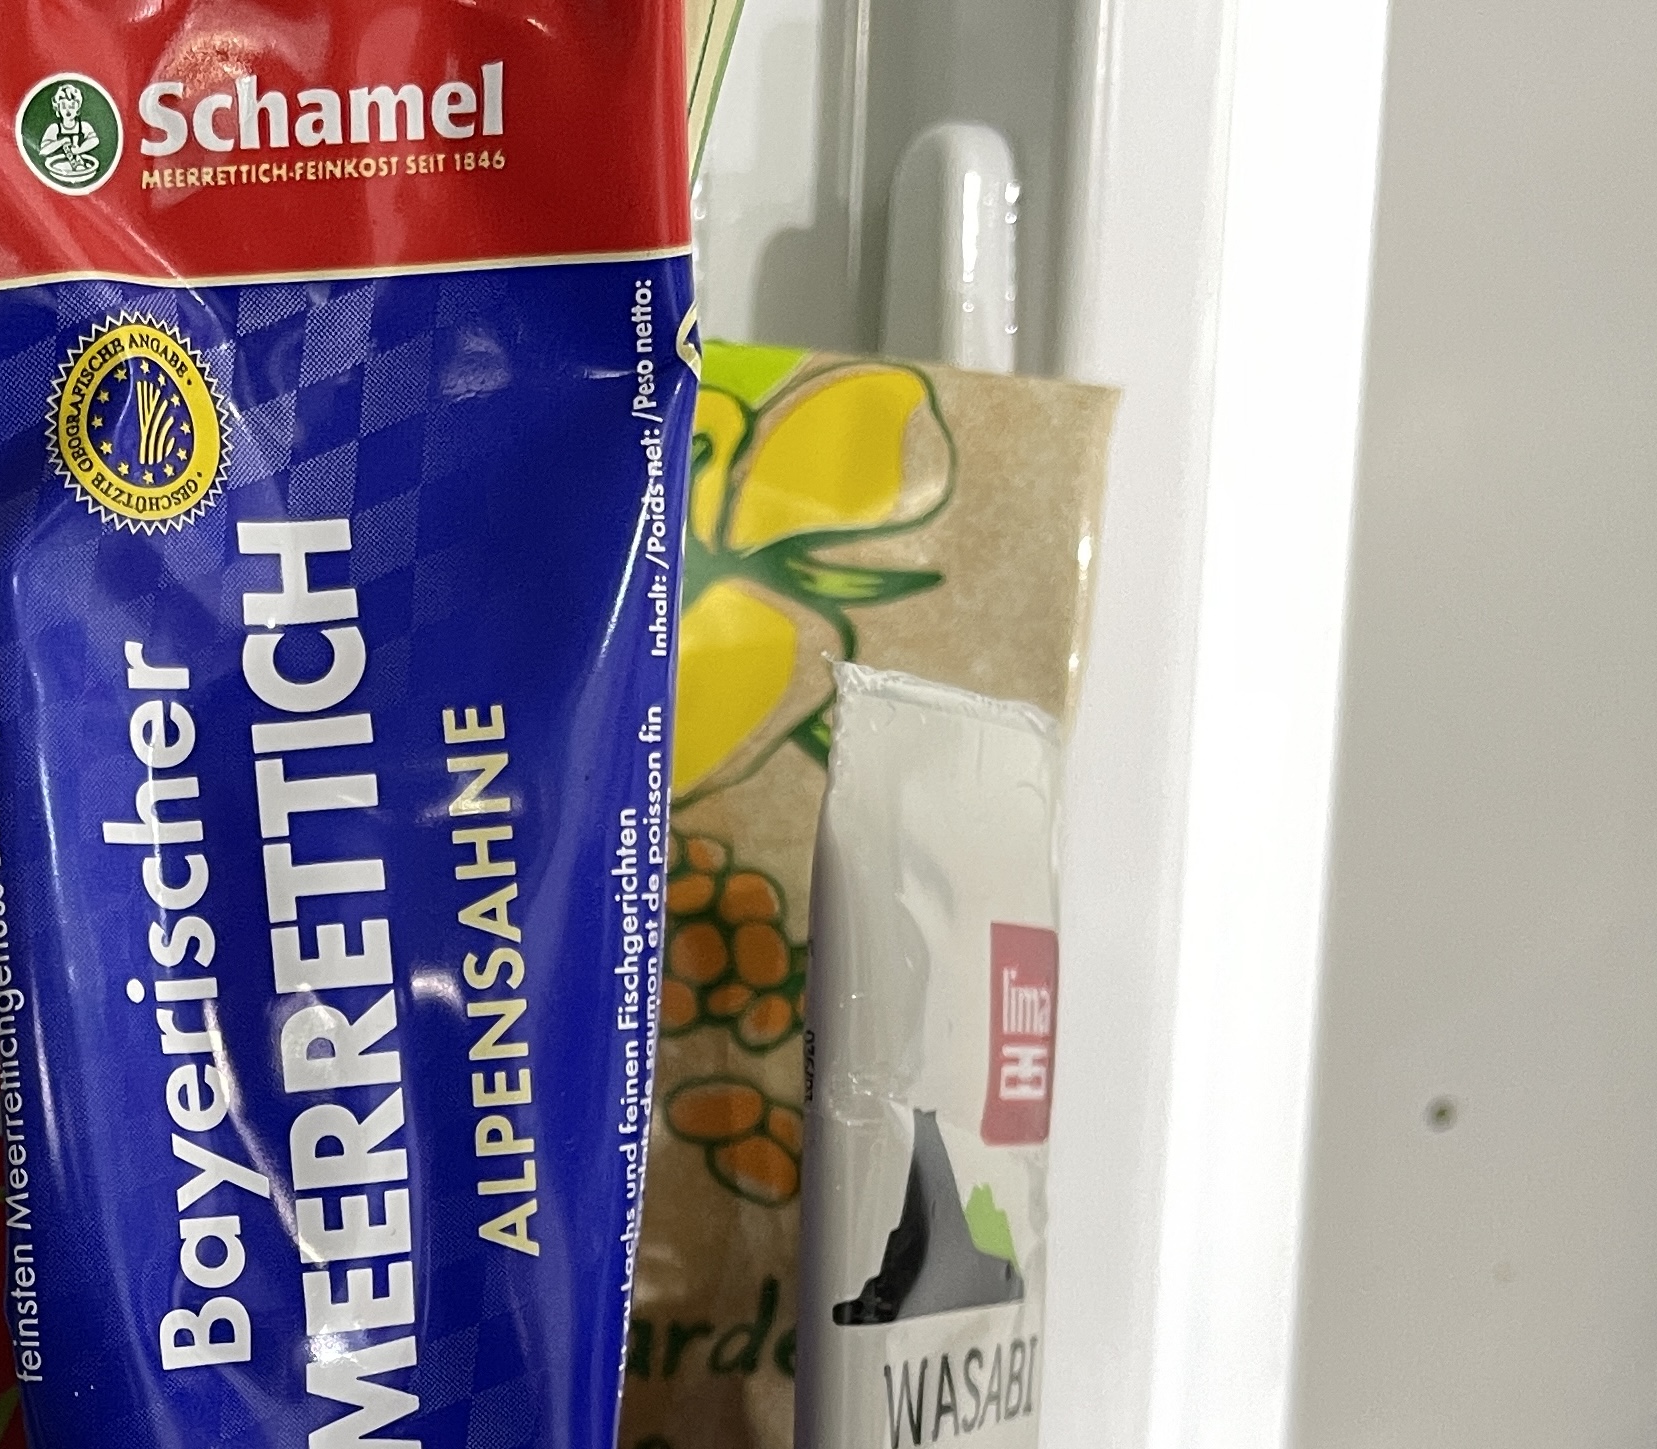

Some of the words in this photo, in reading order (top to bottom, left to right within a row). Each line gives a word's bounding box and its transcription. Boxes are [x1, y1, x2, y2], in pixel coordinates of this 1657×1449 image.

[138, 61, 504, 157] Schamel
[140, 155, 399, 190] MEERRETTICH-FEINKOST
[404, 153, 445, 176] SEIT
[453, 149, 507, 172] 1846
[631, 279, 653, 353] netto:
[65, 336, 126, 473] GEOGRAFISCHE
[128, 333, 189, 378] ANGABE
[649, 576, 668, 656] Inhalt:
[638, 706, 663, 743] fin
[643, 753, 663, 864] poisson
[610, 808, 644, 1031] Fischgerichten
[103, 641, 270, 1371] Bayerischer
[442, 705, 541, 1257] ALPENSAHNE
[619, 1040, 641, 1135] feinen
[618, 1145, 640, 1200] und
[8, 1244, 44, 1382] feinsten
[883, 1335, 1038, 1449] WASABI
